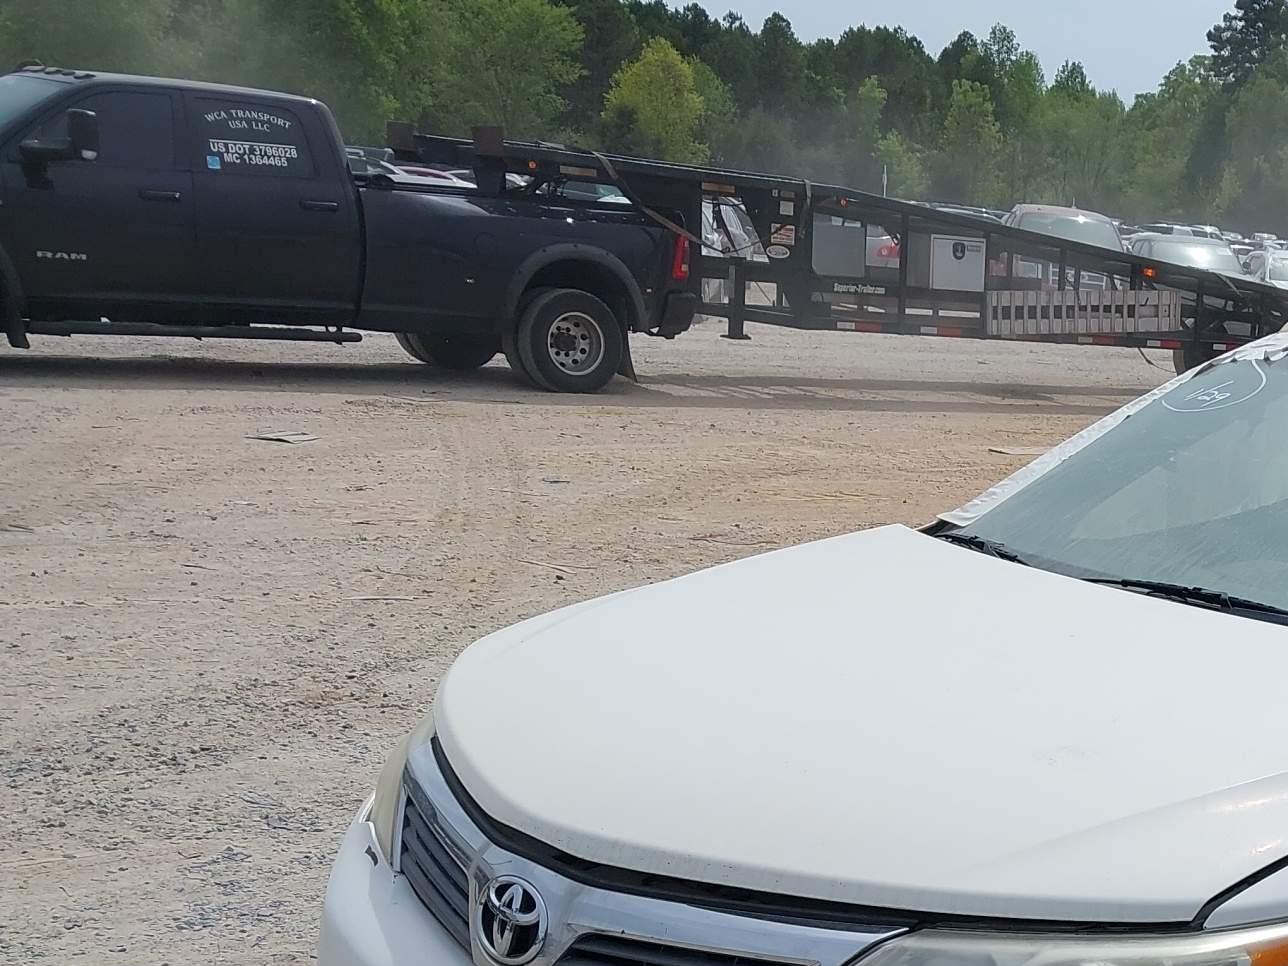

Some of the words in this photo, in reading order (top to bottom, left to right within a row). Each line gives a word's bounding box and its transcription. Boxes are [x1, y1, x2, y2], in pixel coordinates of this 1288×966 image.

[205, 111, 228, 123] WCA
[229, 109, 292, 129] TRANSPORT
[228, 121, 248, 129] USA
[252, 121, 271, 132] LLC
[209, 142, 226, 153] US
[228, 144, 250, 154] DOT
[223, 153, 241, 163] MC
[36, 250, 87, 261] RAM
